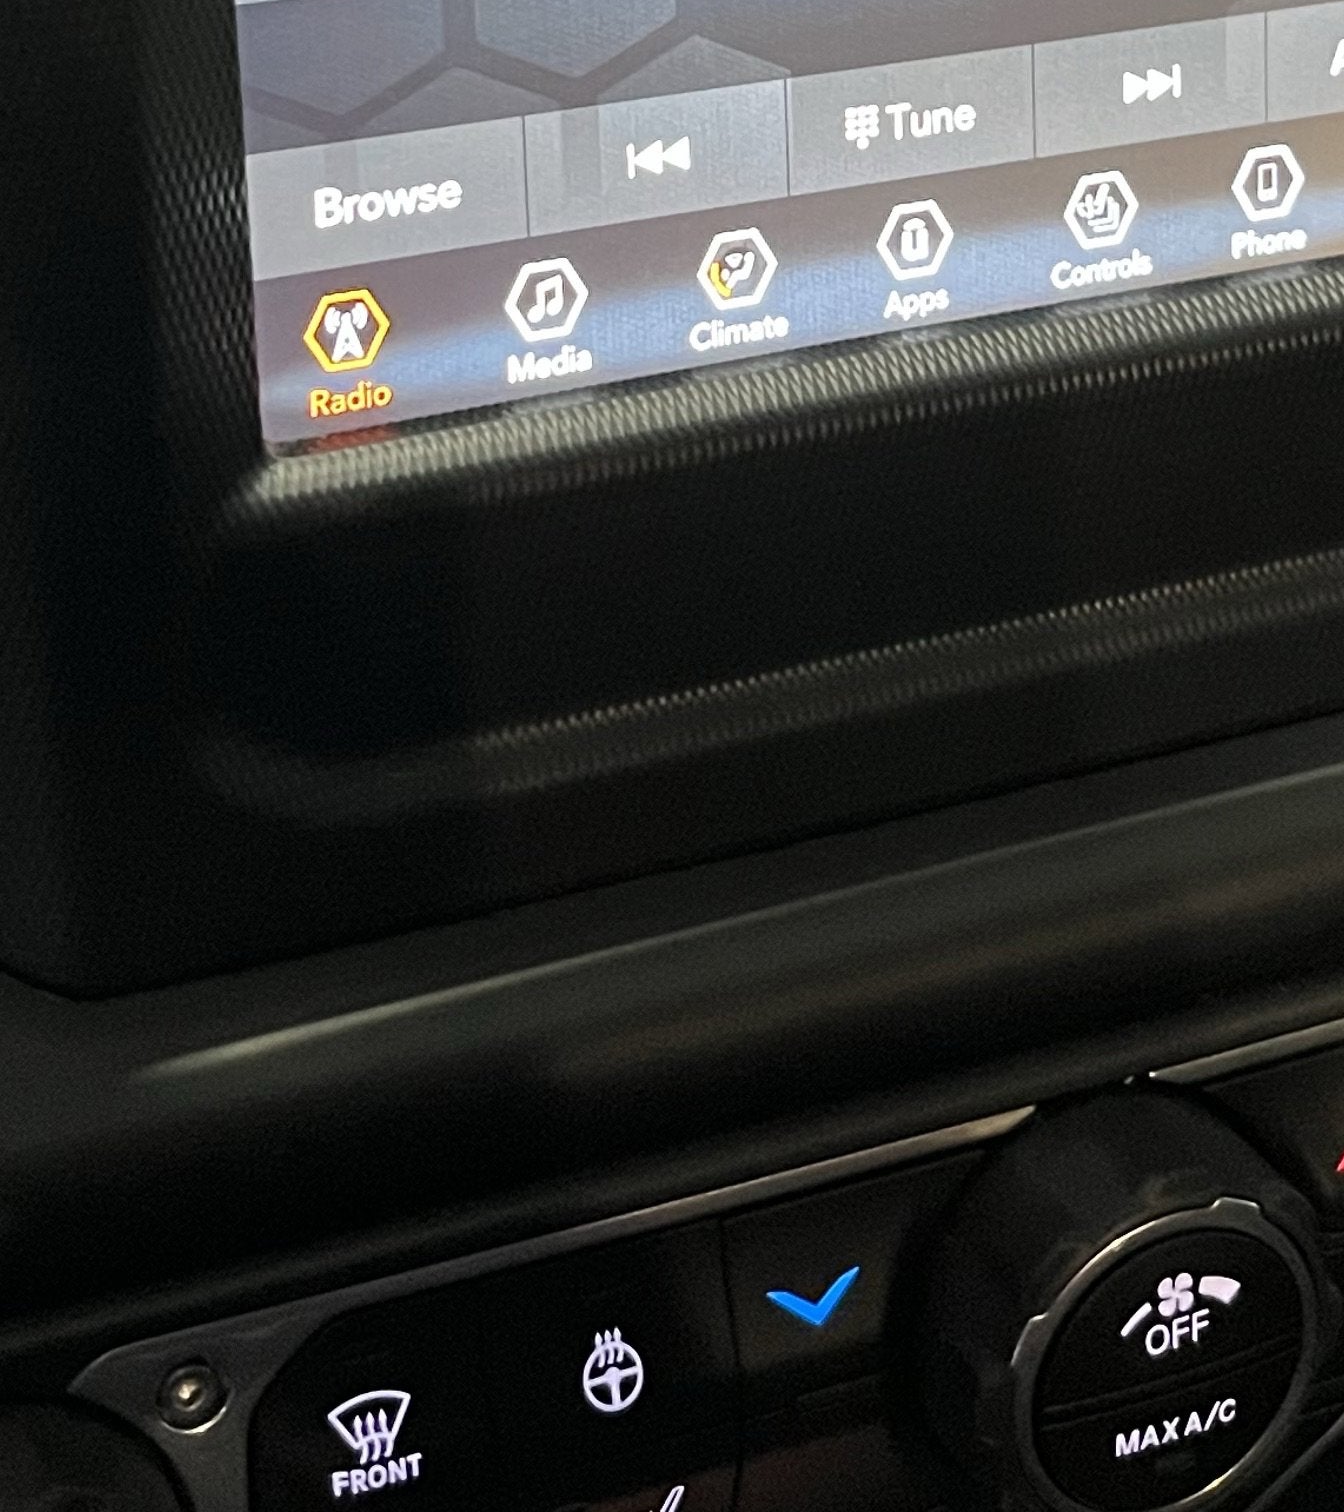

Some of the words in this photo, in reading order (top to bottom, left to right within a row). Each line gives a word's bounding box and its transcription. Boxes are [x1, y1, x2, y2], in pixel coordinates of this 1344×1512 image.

[884, 102, 977, 141] Tune
[313, 179, 463, 229] Browse
[1230, 228, 1308, 260] Phone
[1049, 249, 1154, 290] Controls
[883, 288, 950, 322] Apps
[688, 314, 790, 352] Climate
[506, 344, 593, 385] Media
[308, 382, 393, 418] Radio
[1144, 1307, 1211, 1357] OFF
[1115, 1416, 1181, 1458] MAX
[1183, 1397, 1237, 1437] A/C
[331, 1452, 423, 1498] FRONT
